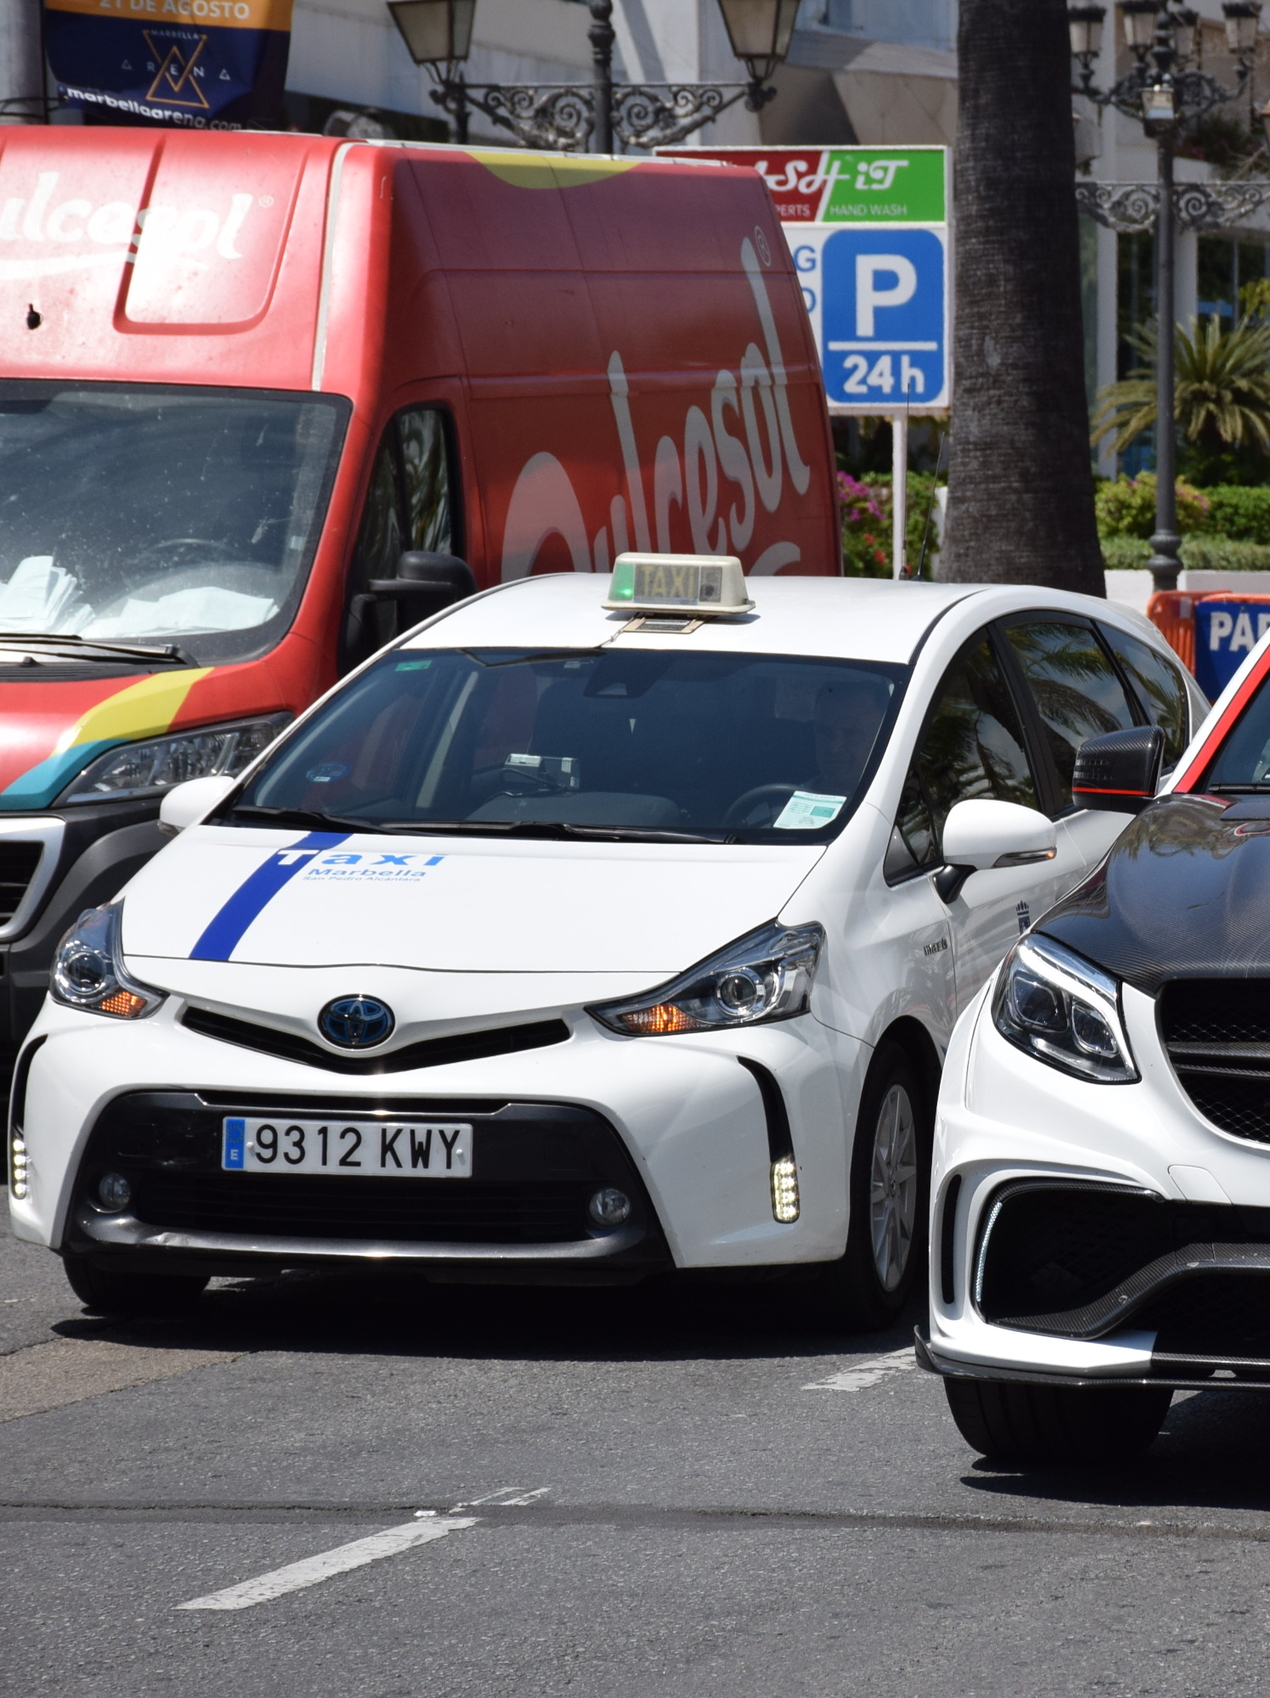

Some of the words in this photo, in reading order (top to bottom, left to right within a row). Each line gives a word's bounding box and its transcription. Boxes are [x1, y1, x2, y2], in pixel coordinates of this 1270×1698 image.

[130, 0, 156, 12] DE
[162, 0, 250, 20] AGOSTO
[151, 29, 201, 40] MARBELLA
[66, 87, 242, 131] marbellaarena.com
[829, 204, 868, 216] HAND
[870, 204, 908, 216] WASH
[856, 253, 918, 338] P
[640, 564, 695, 598] TAXI
[277, 849, 449, 866] Taxi
[308, 868, 427, 877] Marbella
[230, 1149, 239, 1161] E
[255, 1124, 362, 1167] 9312
[380, 1127, 461, 1170] KWY
